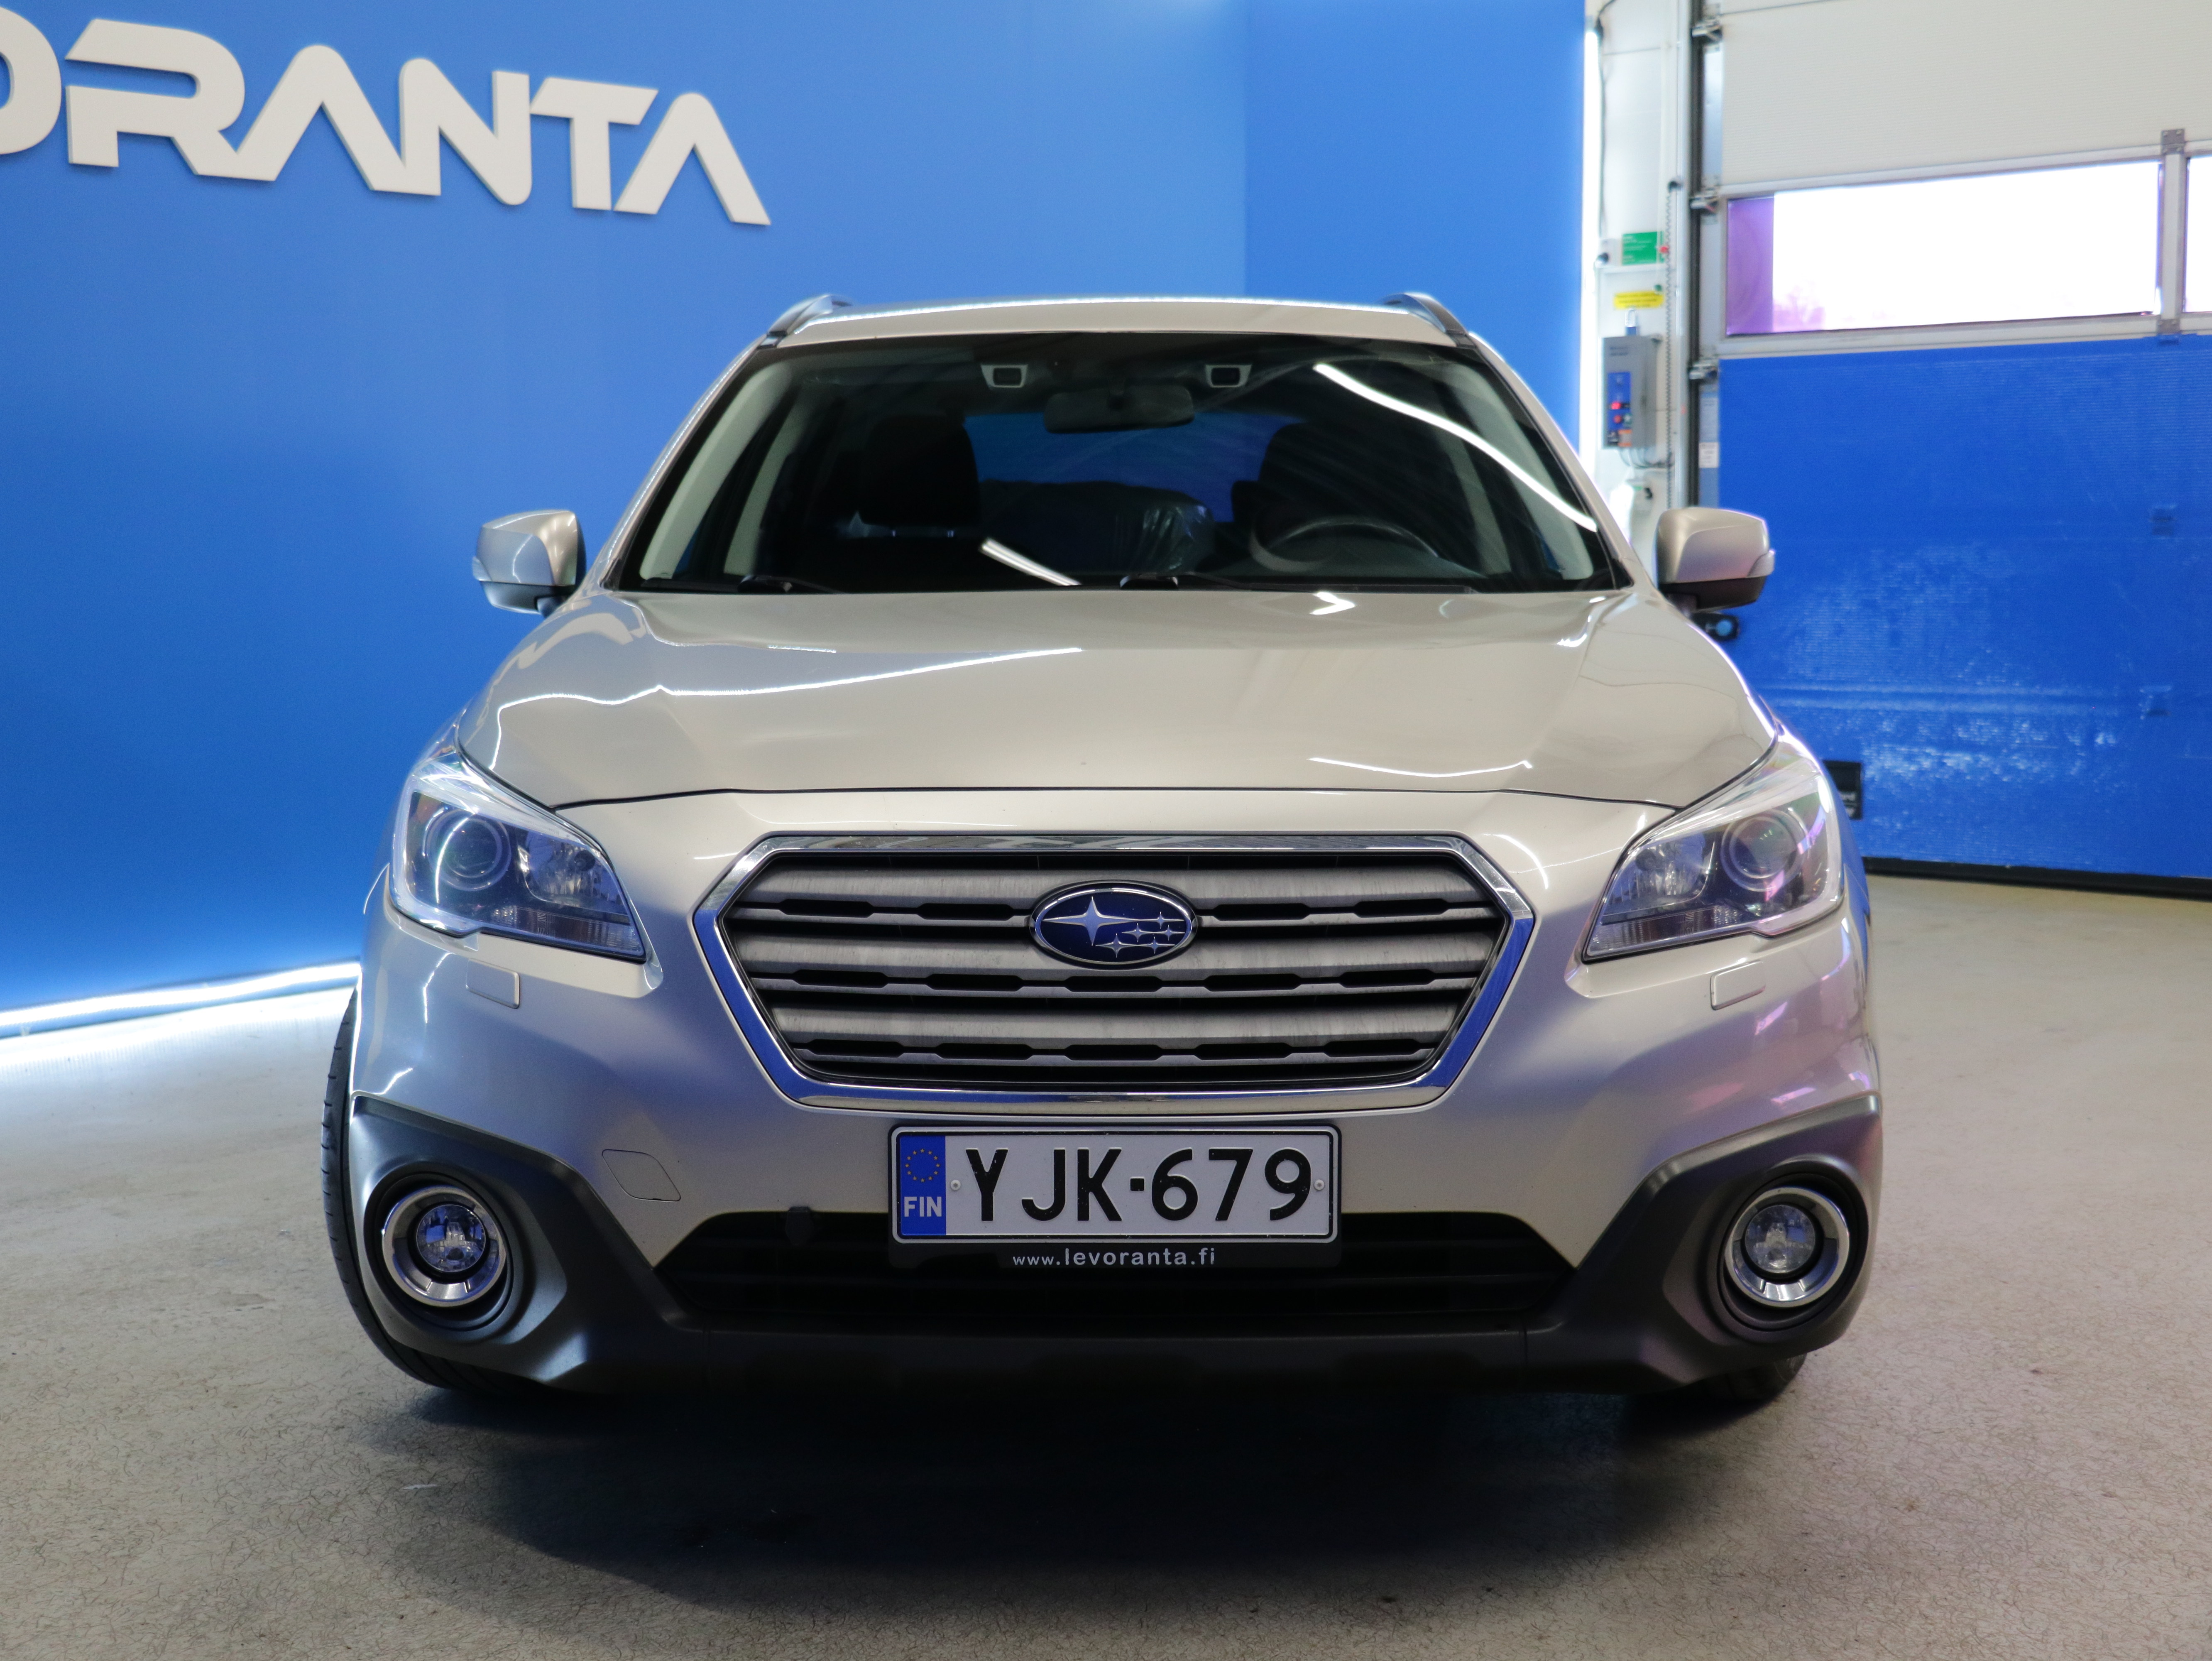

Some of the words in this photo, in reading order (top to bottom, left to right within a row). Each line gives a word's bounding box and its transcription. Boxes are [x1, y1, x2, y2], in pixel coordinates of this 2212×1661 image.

[965, 1149, 1312, 1222] YJK-679
[904, 1196, 942, 1217] FIN
[1013, 1247, 1215, 1266] www.levoranta.fi
